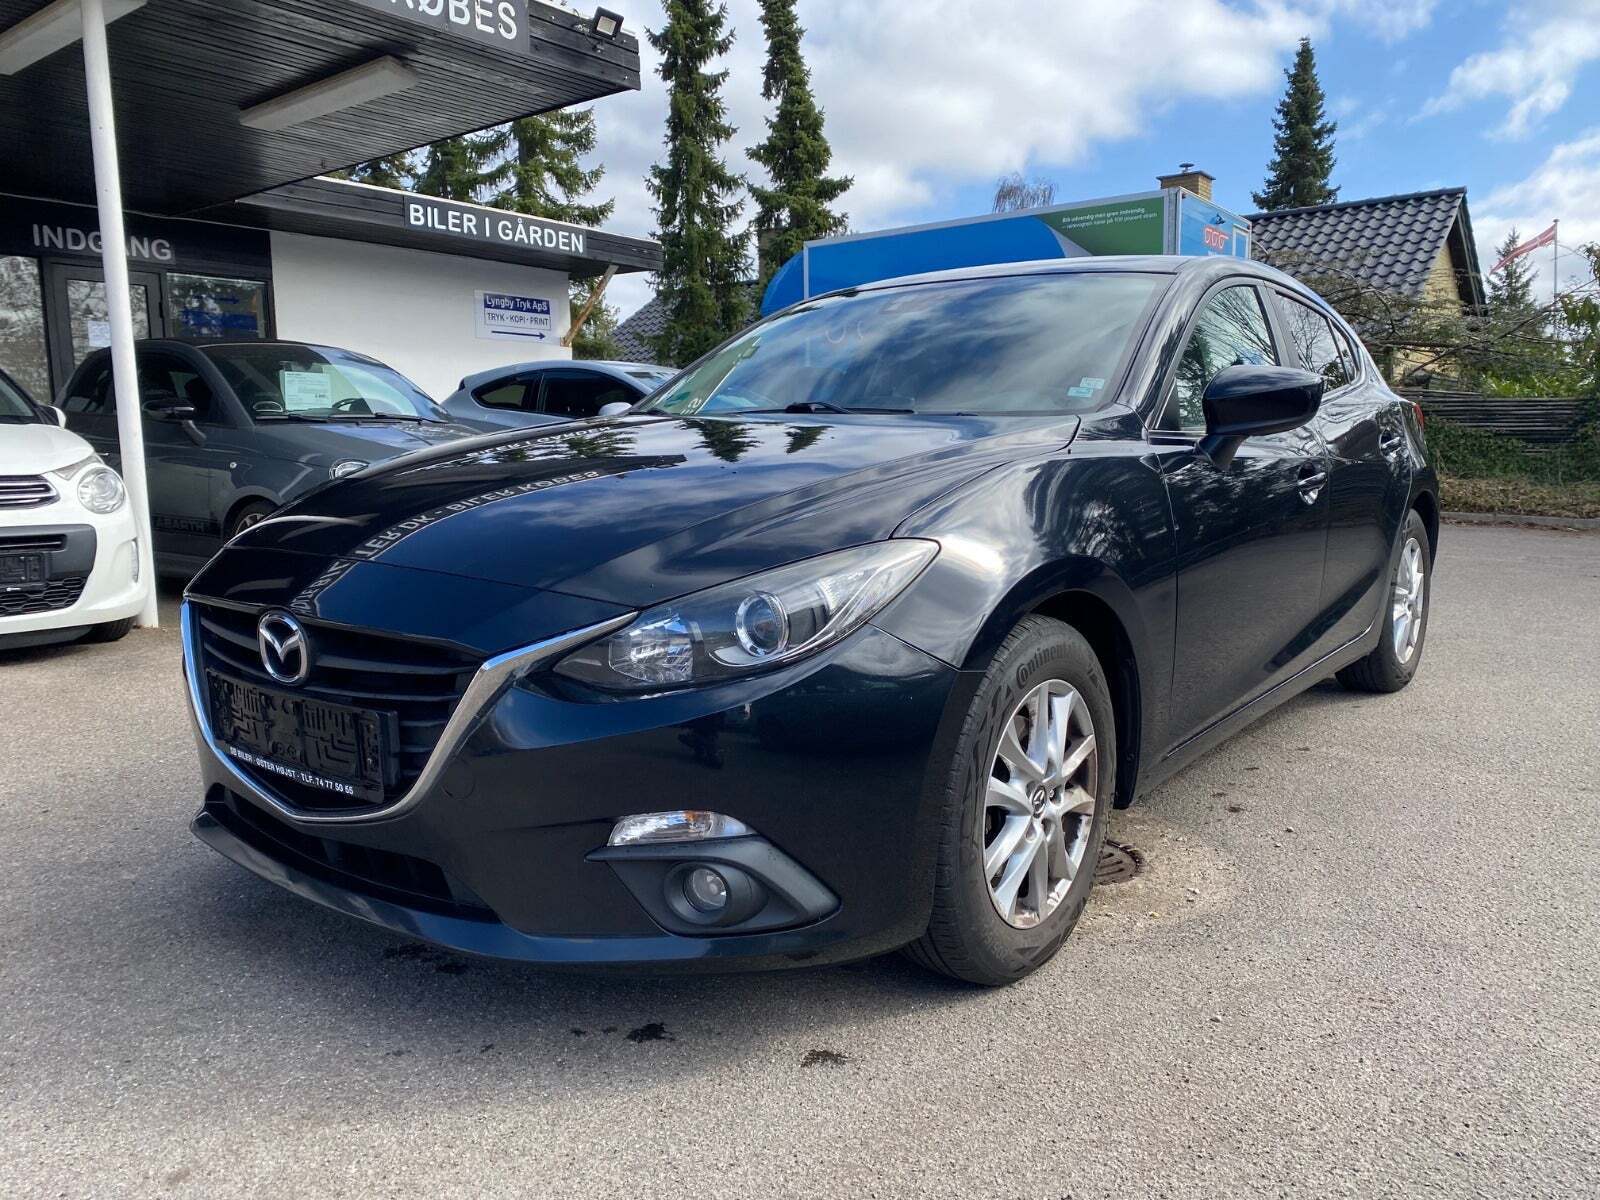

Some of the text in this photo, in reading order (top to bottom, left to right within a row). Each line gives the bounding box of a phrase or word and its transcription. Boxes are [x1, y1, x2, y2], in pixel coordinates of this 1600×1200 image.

[391, 0, 517, 40] BES
[409, 203, 583, 253] BILER I GÅRDEN
[32, 223, 172, 261] INDGNG
[486, 295, 548, 312] Lyngby Tryk ApS
[488, 312, 549, 327] TRYK KOPI PRINT
[315, 777, 324, 788] 74
[325, 780, 333, 790] 77
